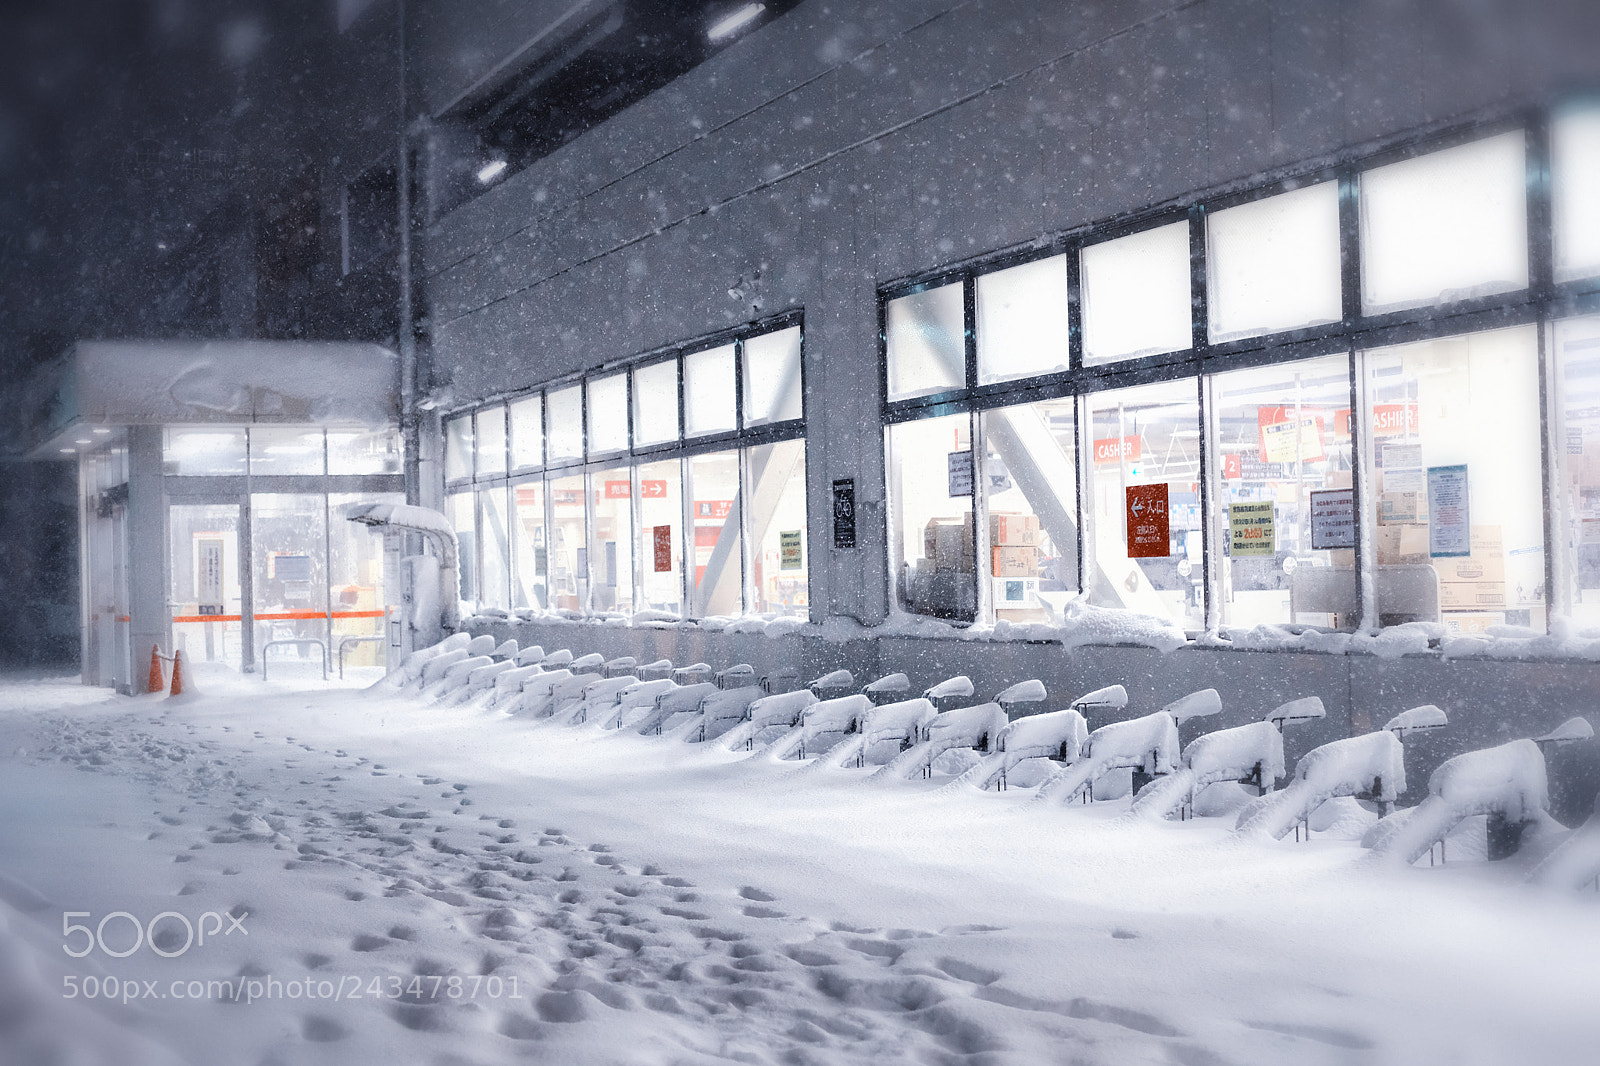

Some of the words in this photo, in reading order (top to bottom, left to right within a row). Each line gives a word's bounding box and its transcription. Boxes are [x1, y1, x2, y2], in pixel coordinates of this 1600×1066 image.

[1373, 410, 1414, 428] ASHIER
[1098, 442, 1133, 459] CASHER
[1229, 461, 1236, 472] 2
[611, 485, 647, 494] 売場口
[1147, 500, 1164, 513] 入口
